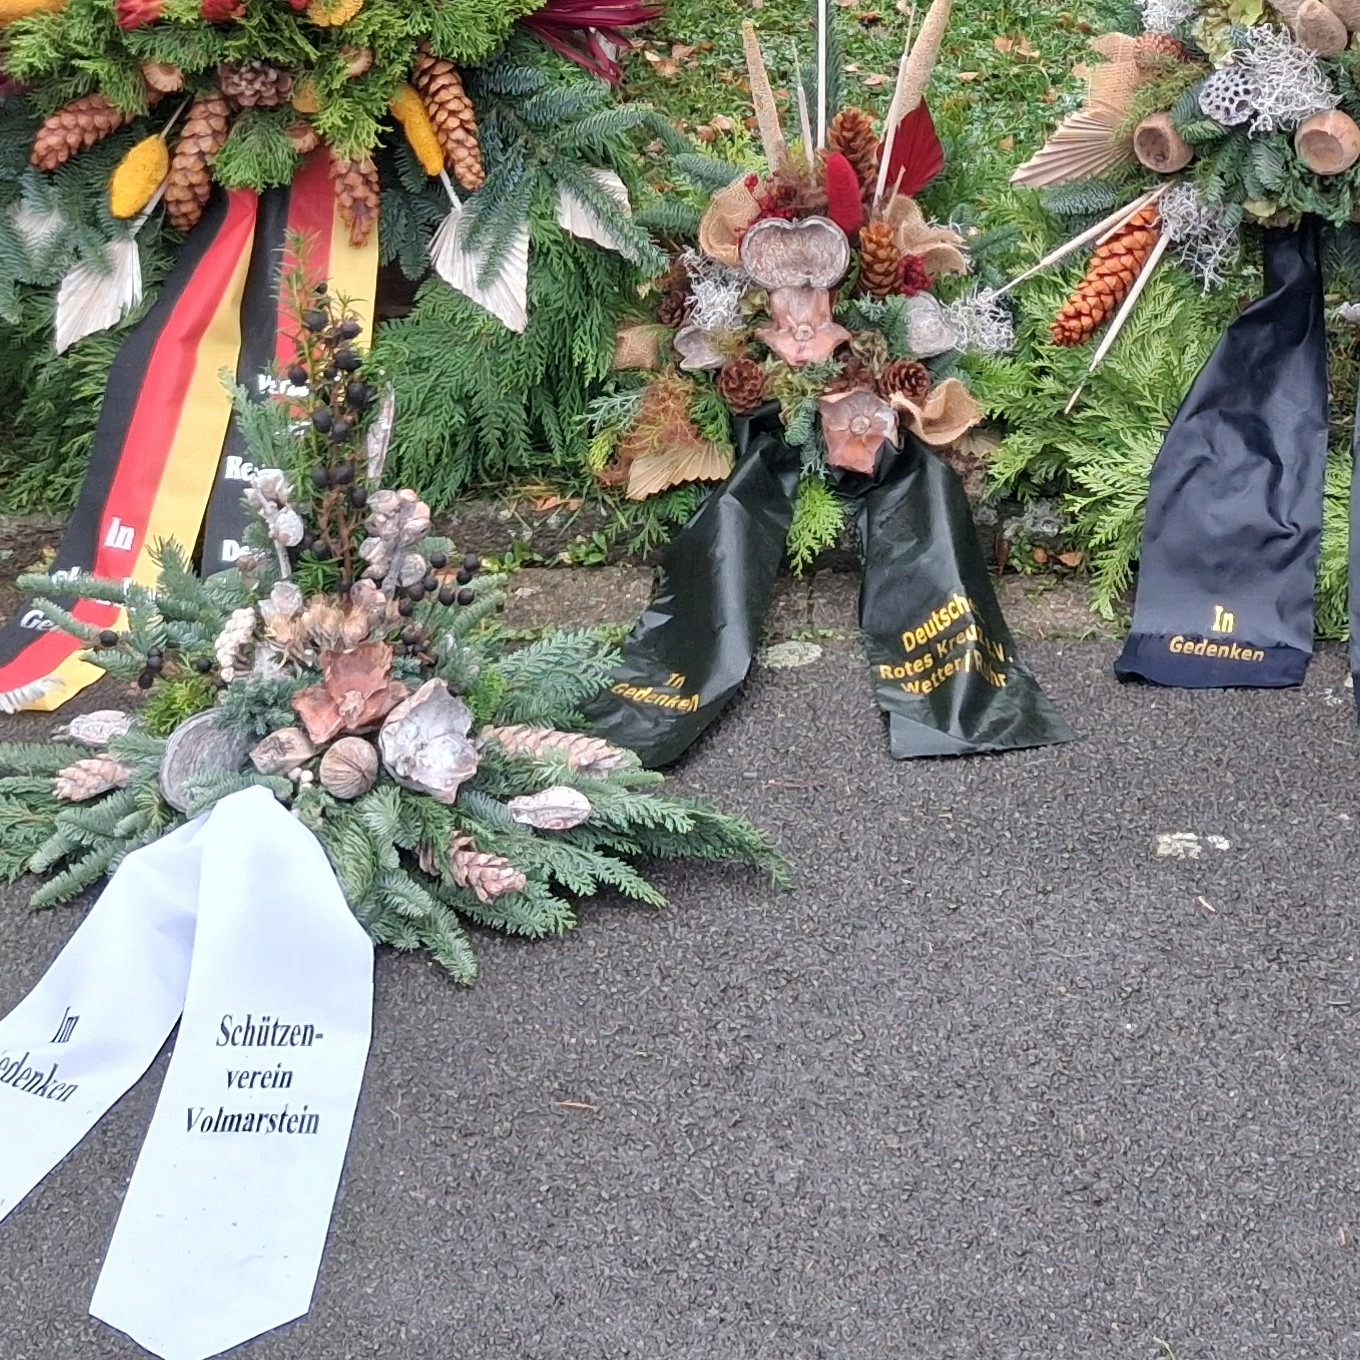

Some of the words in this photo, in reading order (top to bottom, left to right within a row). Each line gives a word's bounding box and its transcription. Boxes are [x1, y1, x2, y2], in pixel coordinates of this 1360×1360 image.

[103, 516, 136, 551] In
[901, 592, 984, 654] Deutsch
[1211, 605, 1234, 633] In
[1169, 635, 1265, 662] Gedenken
[662, 672, 686, 689] In
[879, 652, 934, 680] Rotes
[611, 682, 699, 713] Gedenken
[215, 1013, 324, 1047] Schützen-
[226, 1061, 294, 1090] verein
[186, 1102, 320, 1135] Volmarstein
